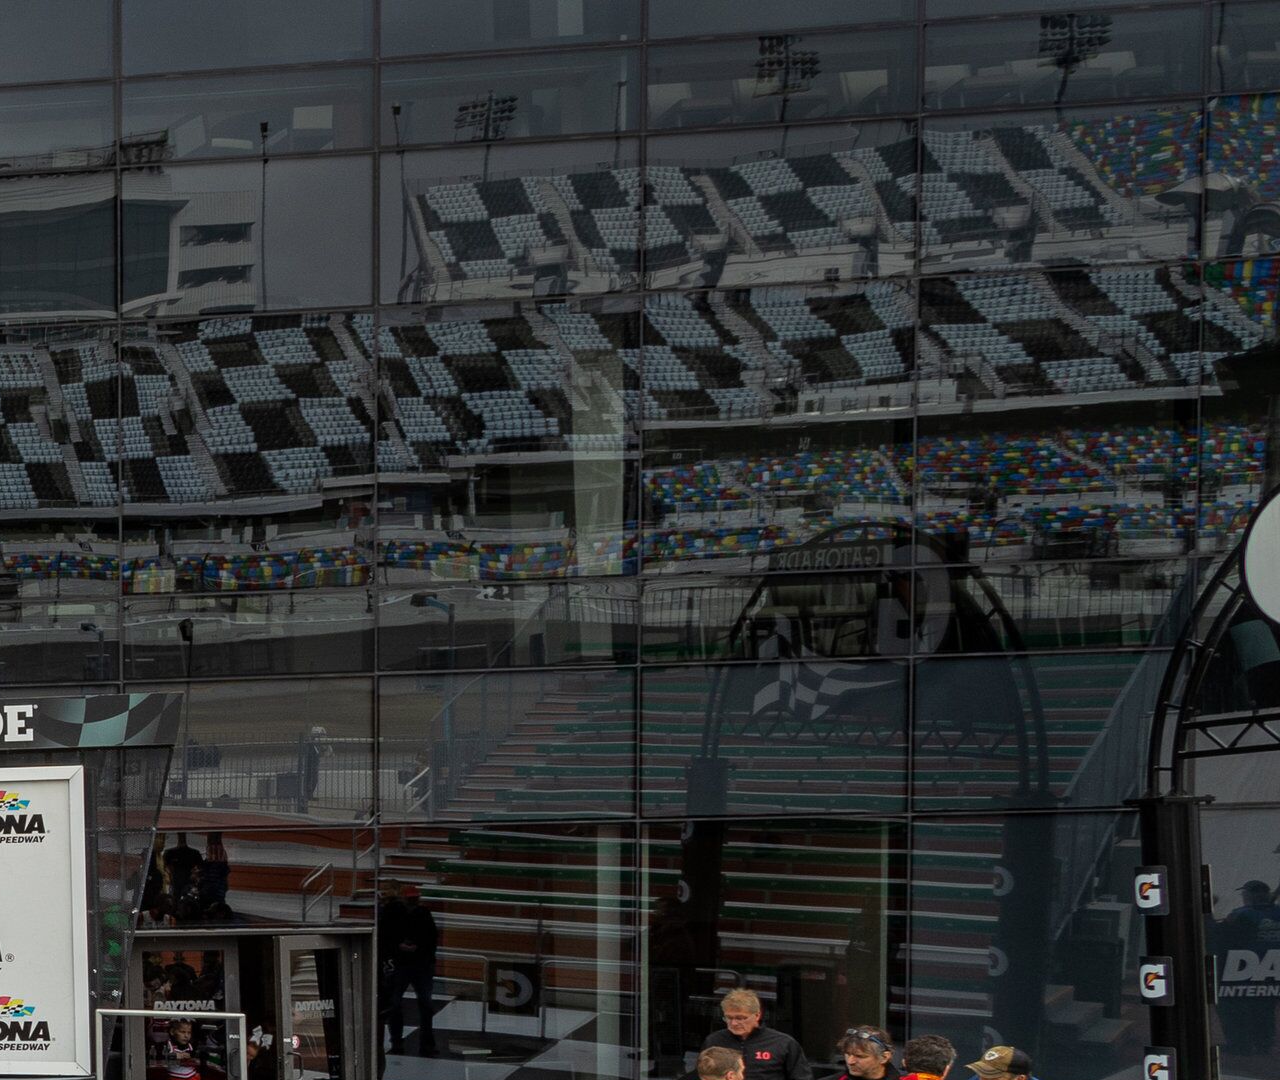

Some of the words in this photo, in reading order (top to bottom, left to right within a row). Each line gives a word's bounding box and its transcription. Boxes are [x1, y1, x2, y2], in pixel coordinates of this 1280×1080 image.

[1135, 873, 1161, 909] G
[1141, 963, 1167, 998] G
[153, 1000, 216, 1011] DAYTONA
[294, 999, 334, 1012] DAYTONA
[755, 1052, 771, 1060] 10
